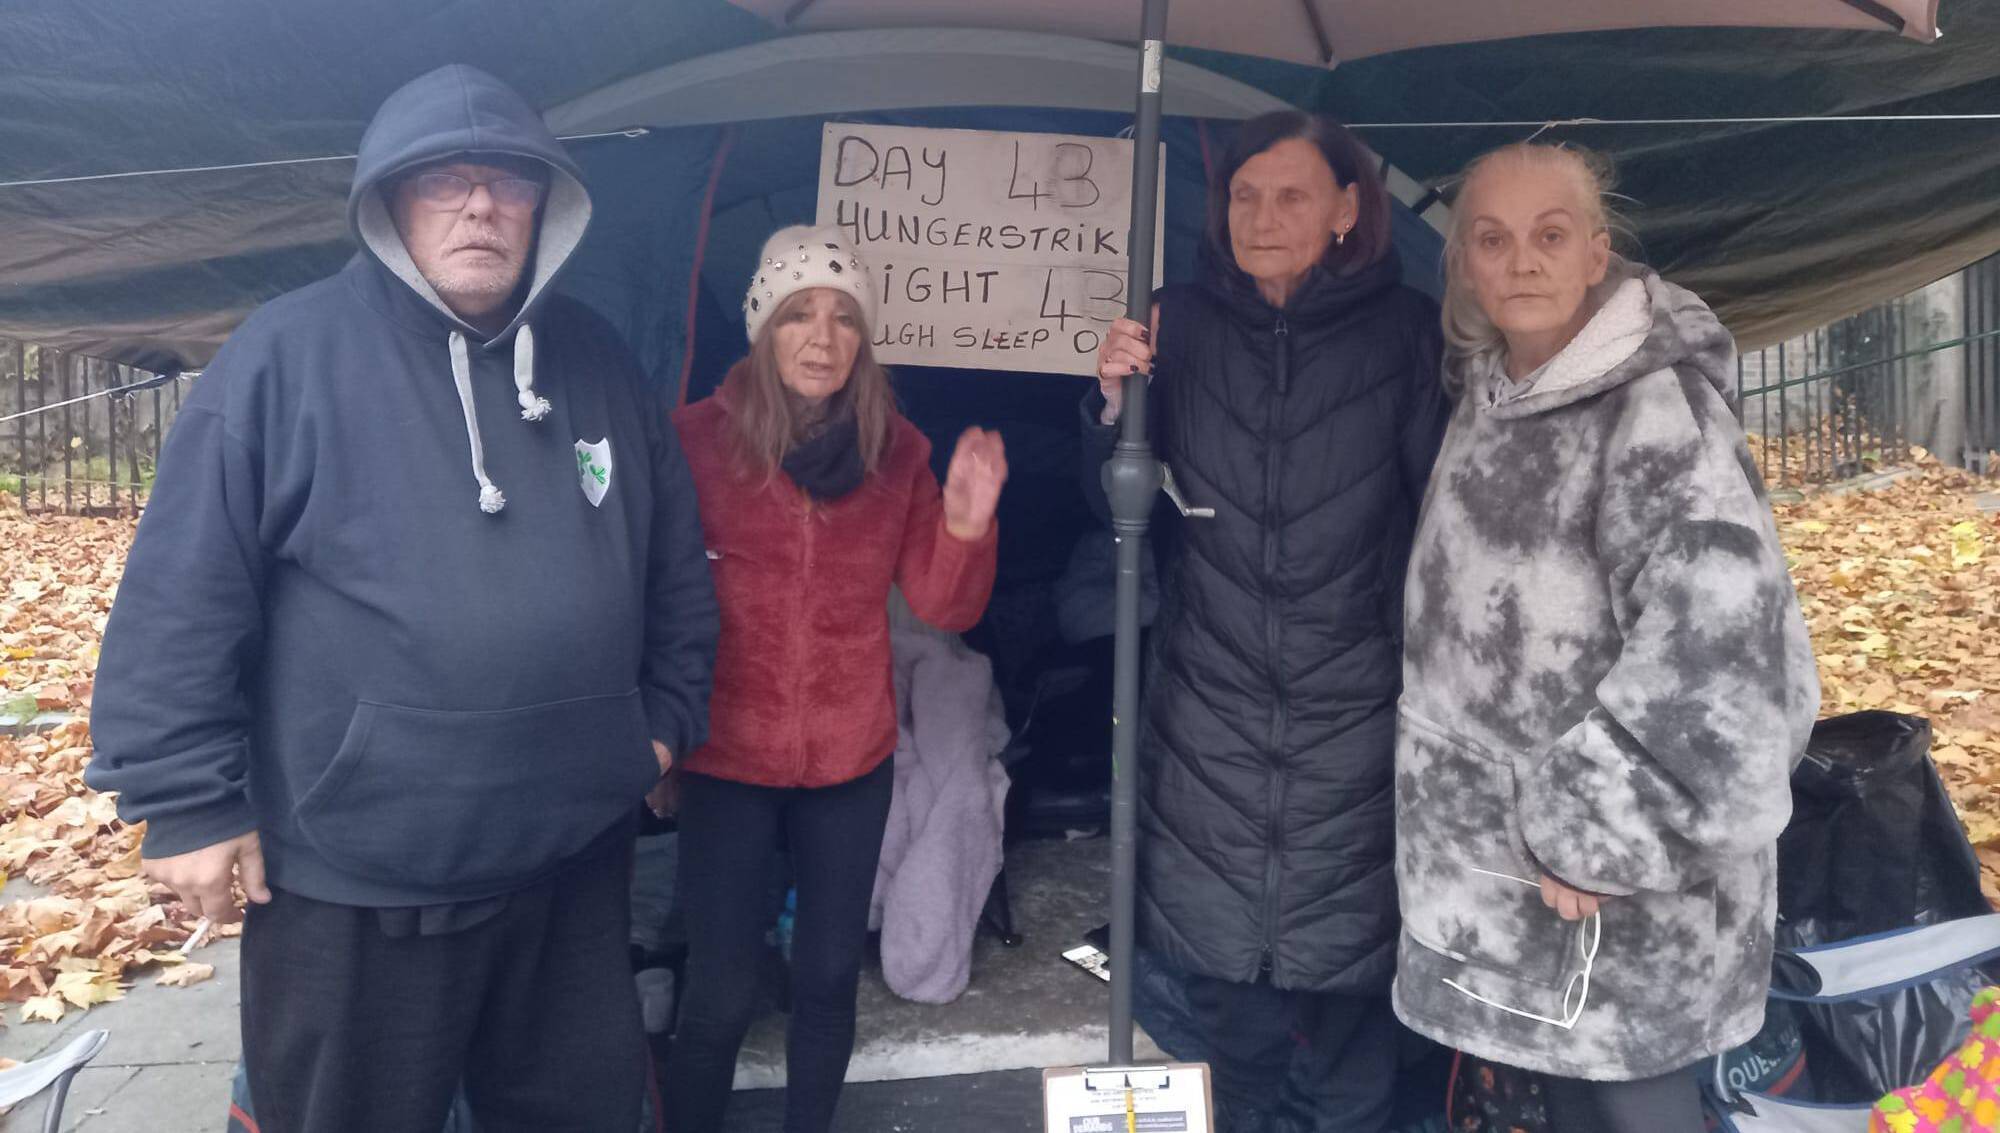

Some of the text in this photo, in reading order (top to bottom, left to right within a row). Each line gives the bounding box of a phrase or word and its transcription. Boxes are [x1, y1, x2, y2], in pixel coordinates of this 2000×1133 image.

[834, 135, 1100, 211] DAY 43
[837, 199, 1119, 255] HUNGERSTRiK
[1039, 268, 1128, 332] 43
[872, 322, 934, 348] UGH
[953, 326, 1050, 350] SLEEP
